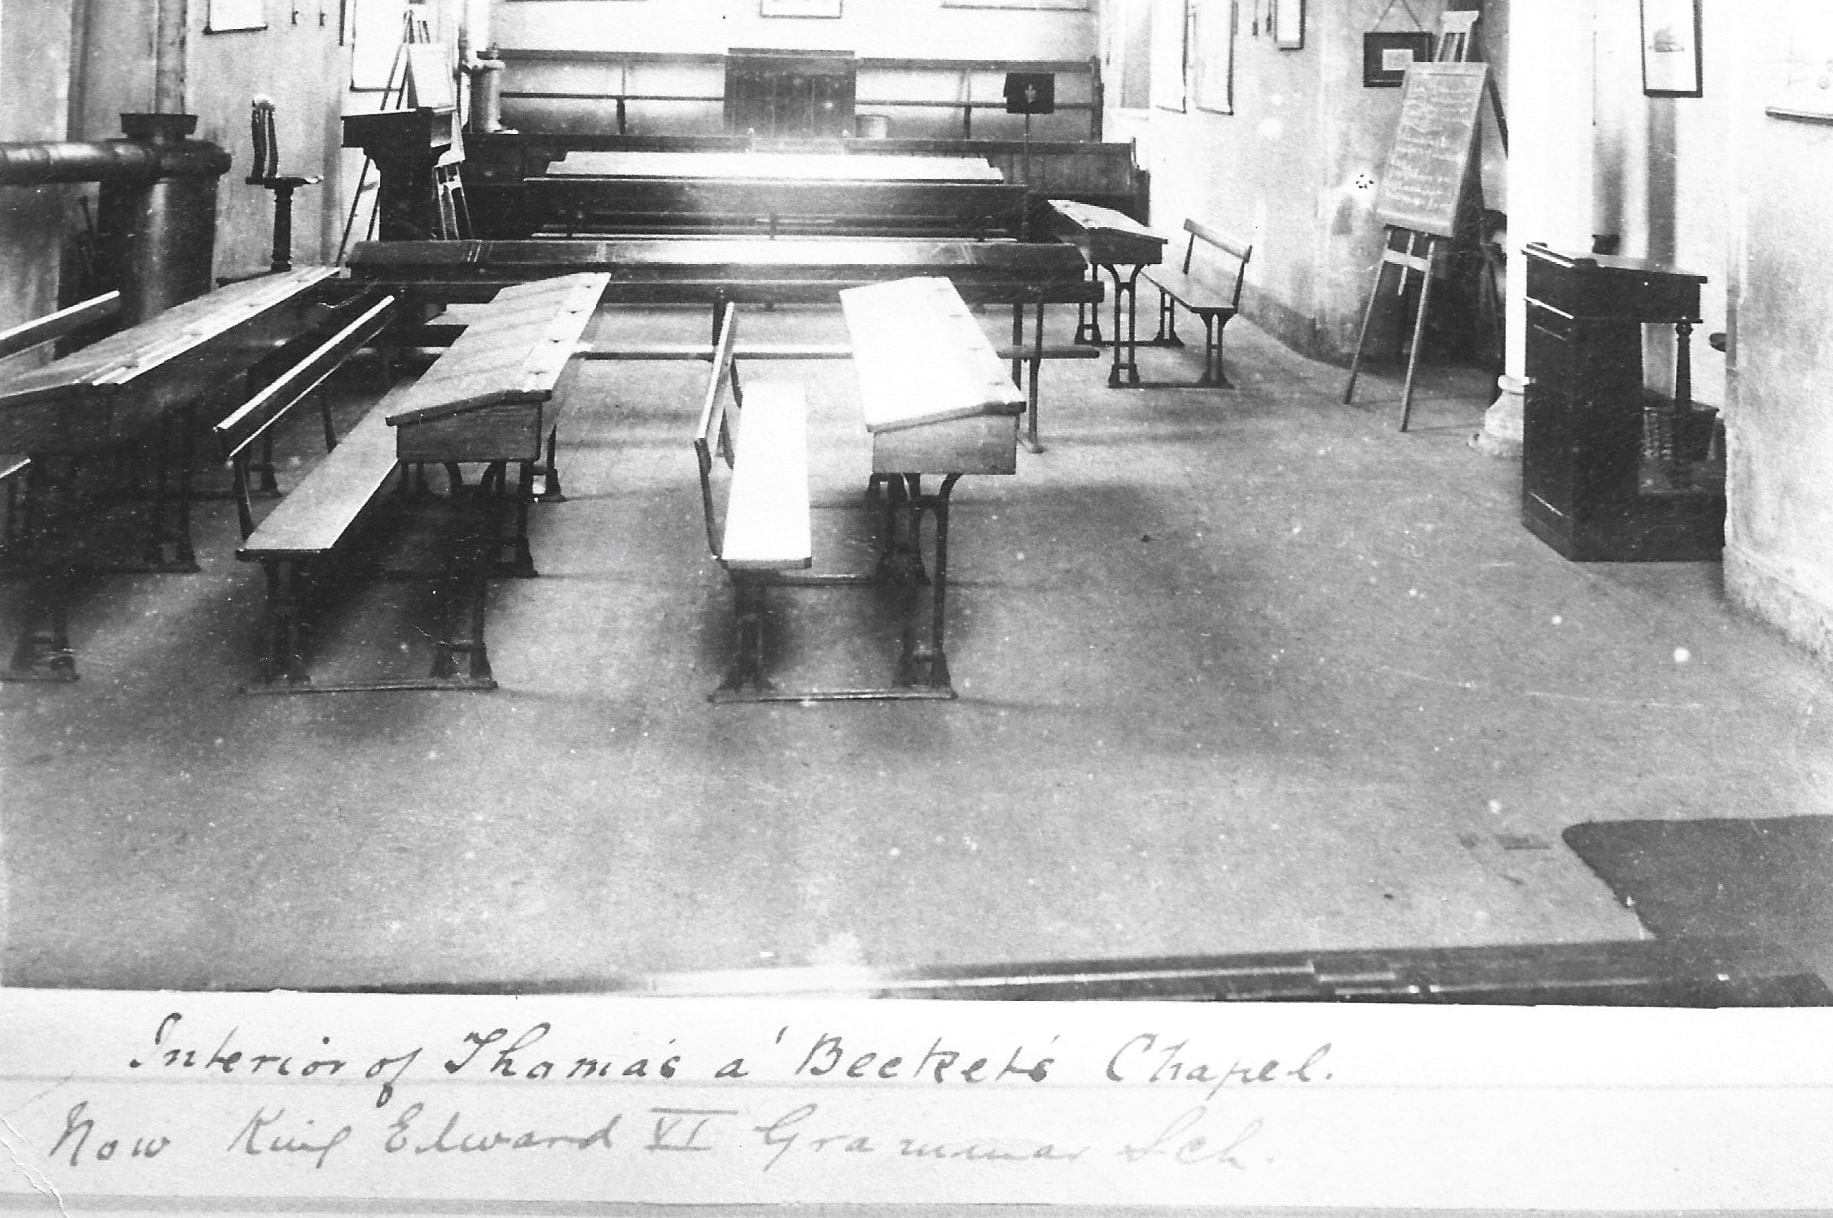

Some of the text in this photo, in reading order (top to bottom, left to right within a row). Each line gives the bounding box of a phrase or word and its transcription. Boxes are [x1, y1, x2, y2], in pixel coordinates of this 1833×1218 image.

[130, 1013, 346, 1075] Interior
[365, 1047, 423, 1108] of
[49, 1100, 170, 1167] Now
[227, 1106, 352, 1169] King
[385, 1102, 622, 1154] Edward
[643, 1107, 738, 1153] VI
